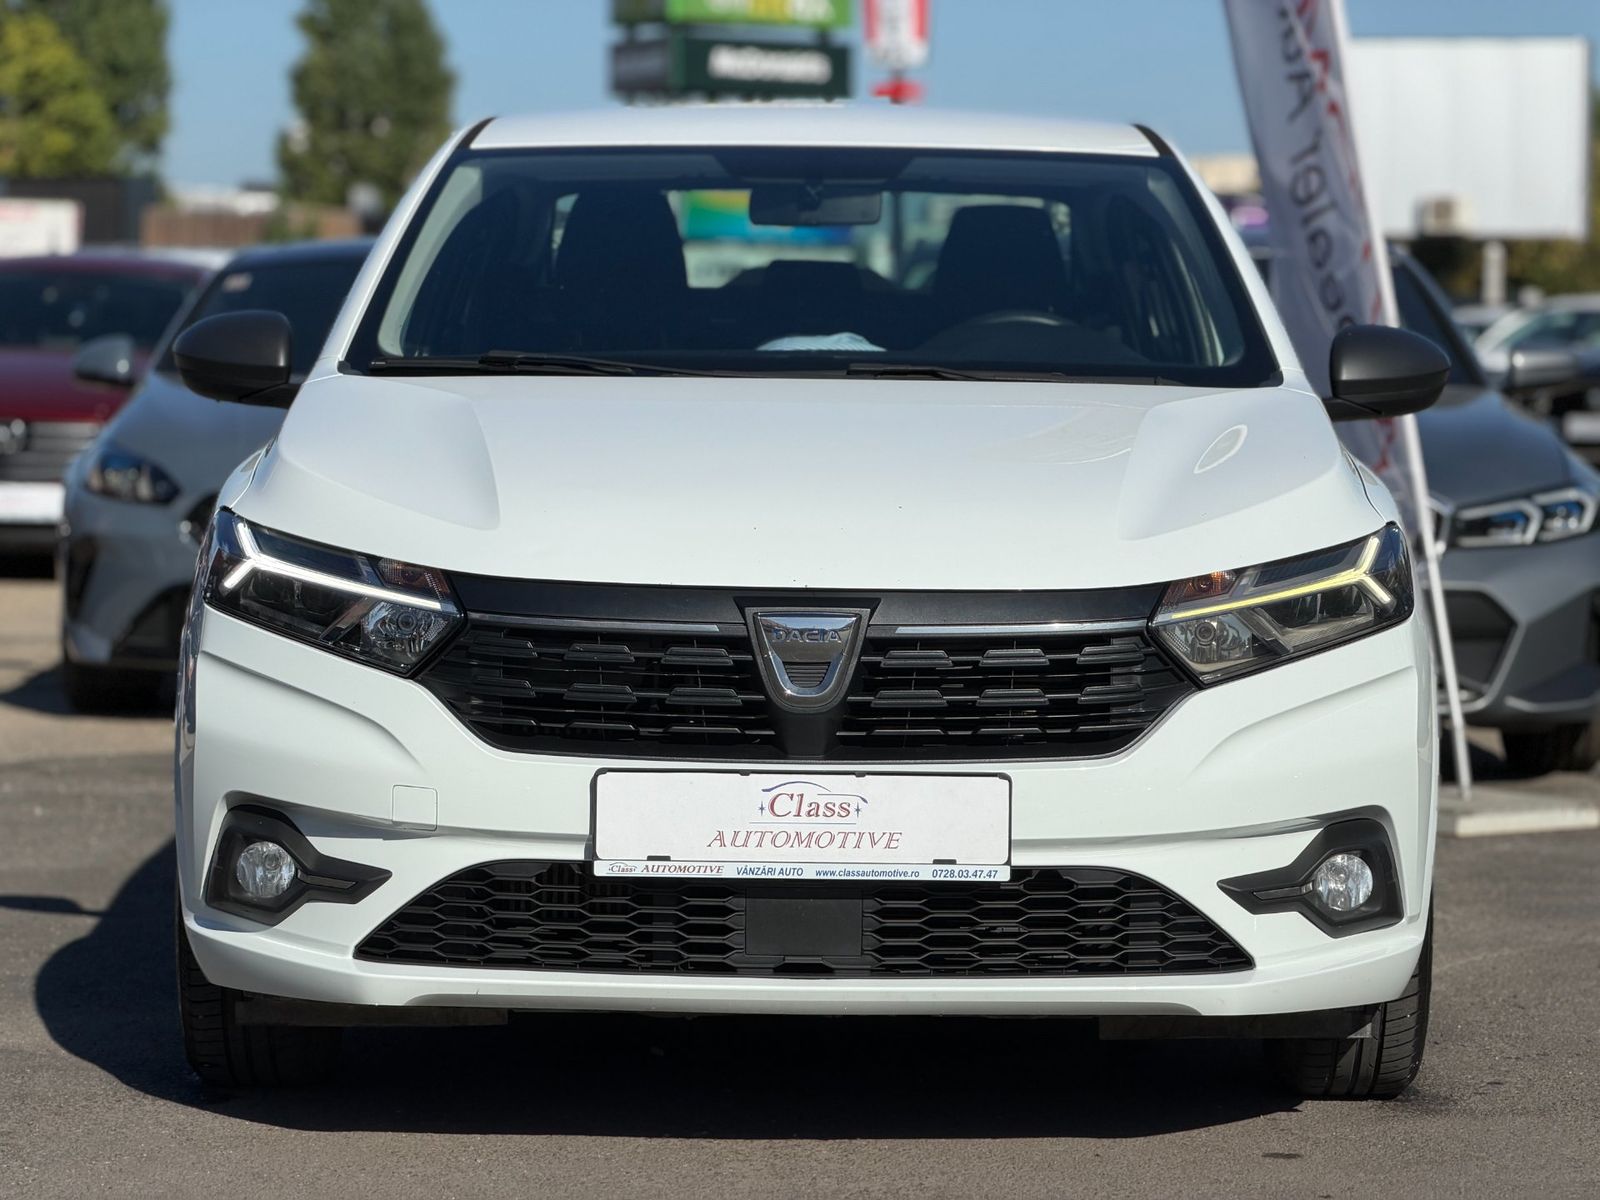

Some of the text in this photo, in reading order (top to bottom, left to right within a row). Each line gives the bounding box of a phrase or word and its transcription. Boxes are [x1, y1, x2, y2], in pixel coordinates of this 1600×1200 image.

[771, 627, 842, 643] DACIA
[767, 792, 851, 818] Class
[706, 830, 903, 850] AUTOMOTIVE
[610, 862, 999, 880] Class AUTOMOTIVE VÂNZĂRI AUTO www.classautomotive.ro 0728.03.47.47
